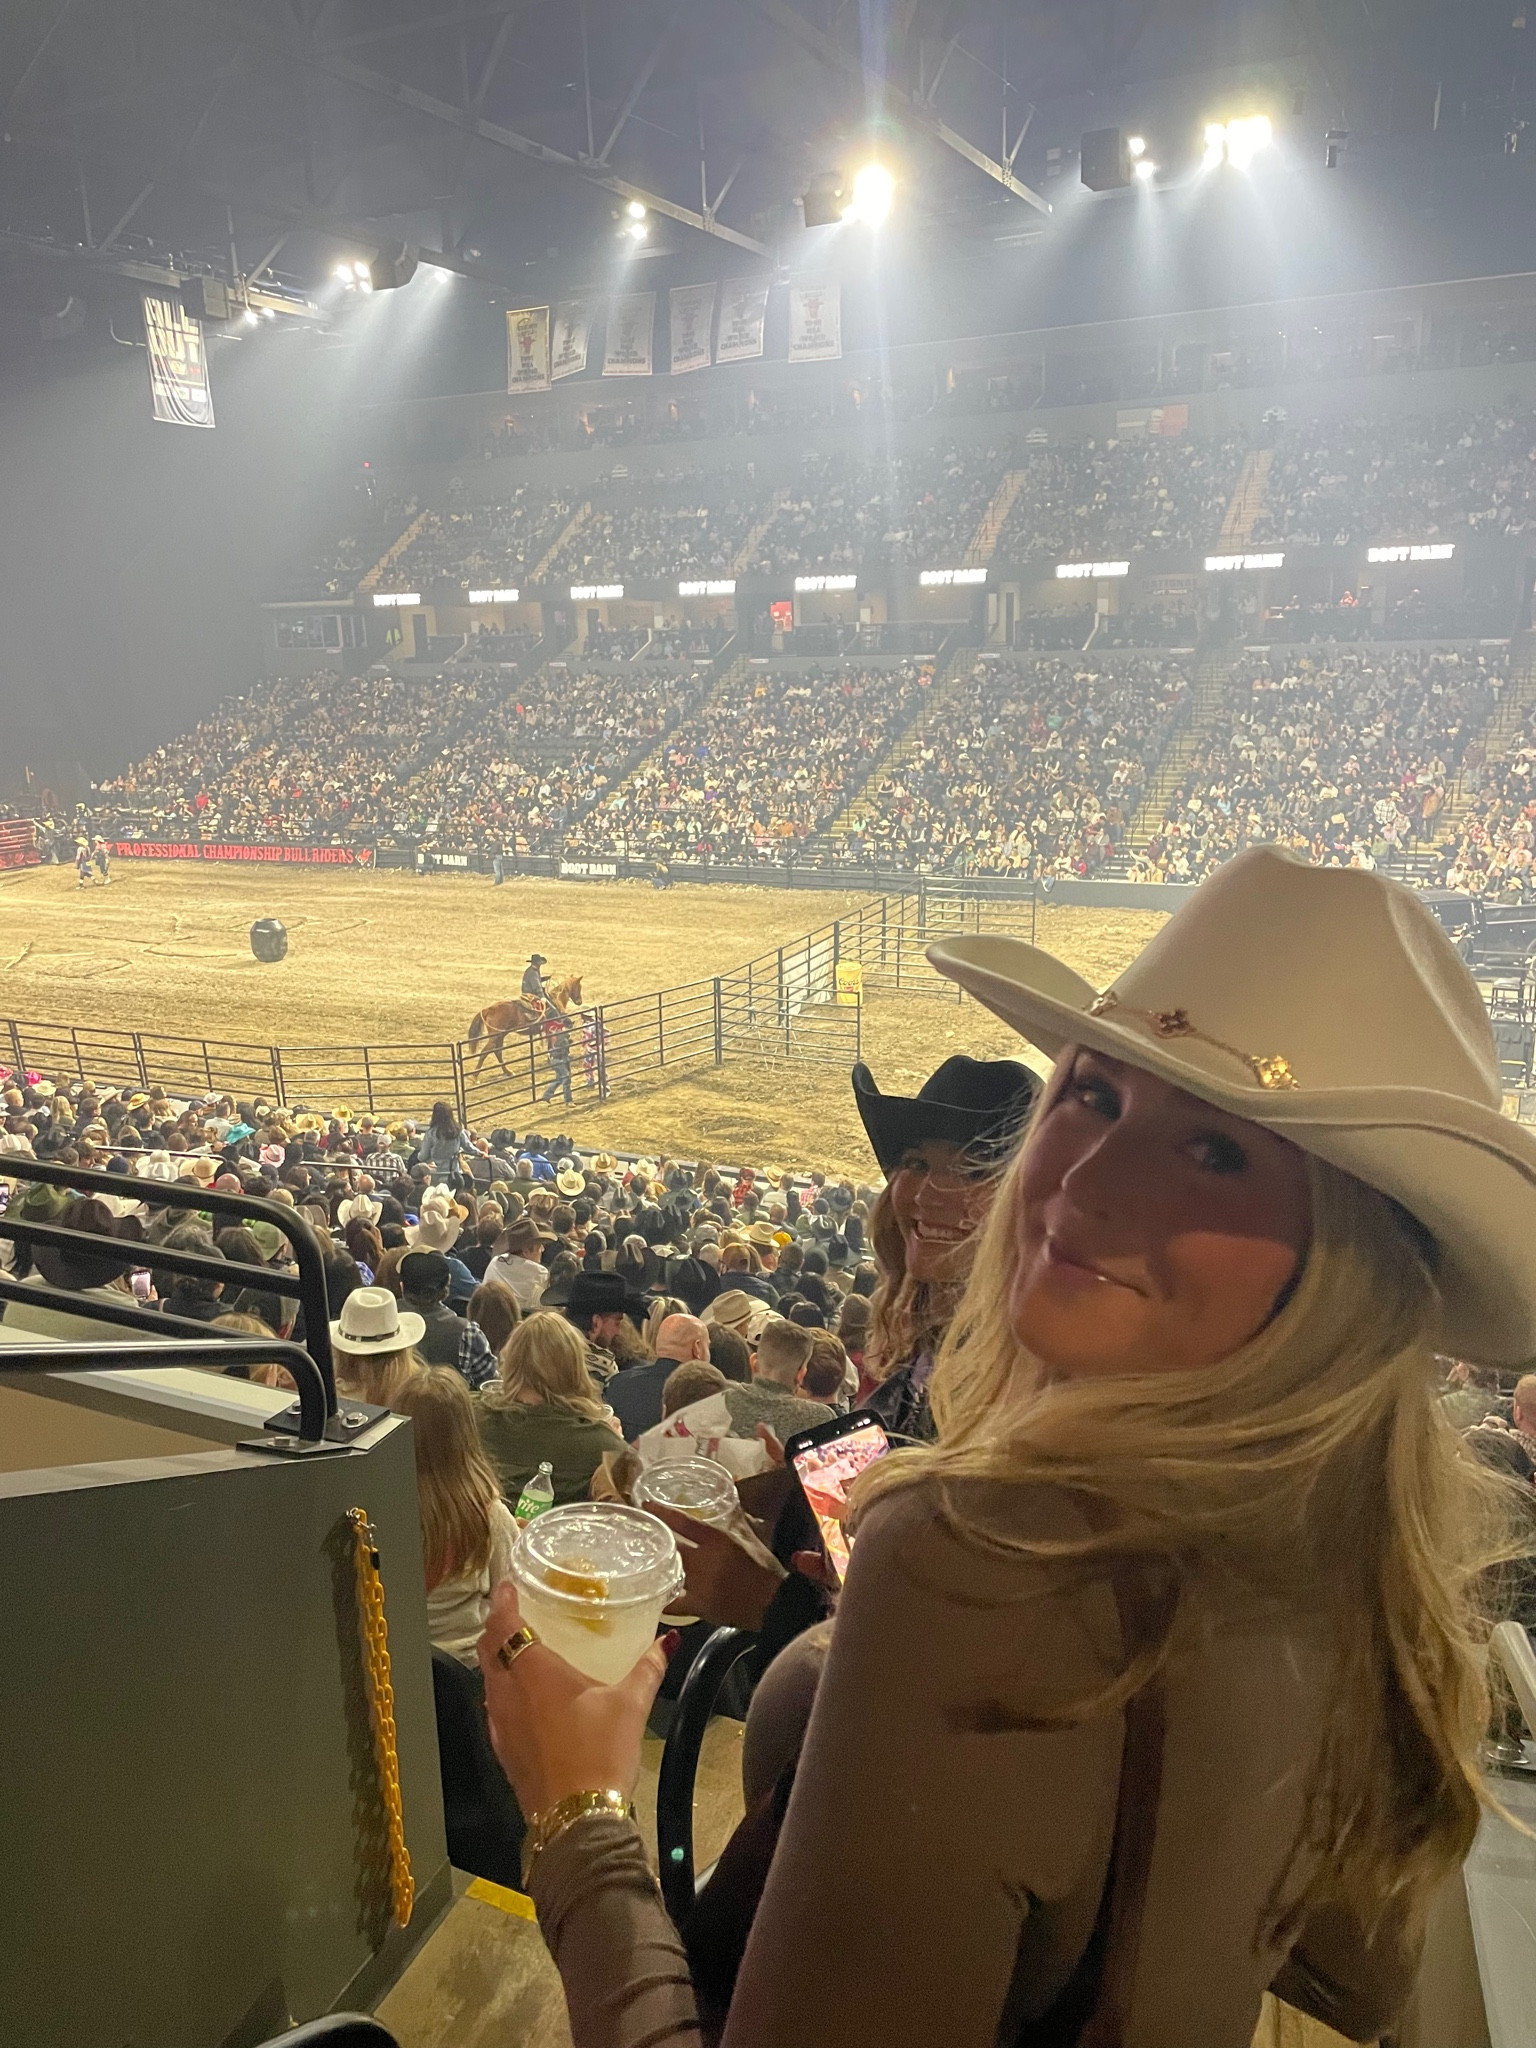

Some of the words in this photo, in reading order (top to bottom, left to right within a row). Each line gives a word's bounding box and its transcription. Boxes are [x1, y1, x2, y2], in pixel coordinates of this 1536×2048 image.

[116, 842, 201, 858] PROFESSIONAL
[203, 844, 283, 861] CHAMPIONSHIP
[284, 846, 310, 862] BULL
[312, 848, 354, 864] RIDERS
[417, 853, 442, 865] BT
[442, 854, 468, 866] BARN
[561, 862, 588, 874] BOOT
[589, 863, 617, 875] BARN
